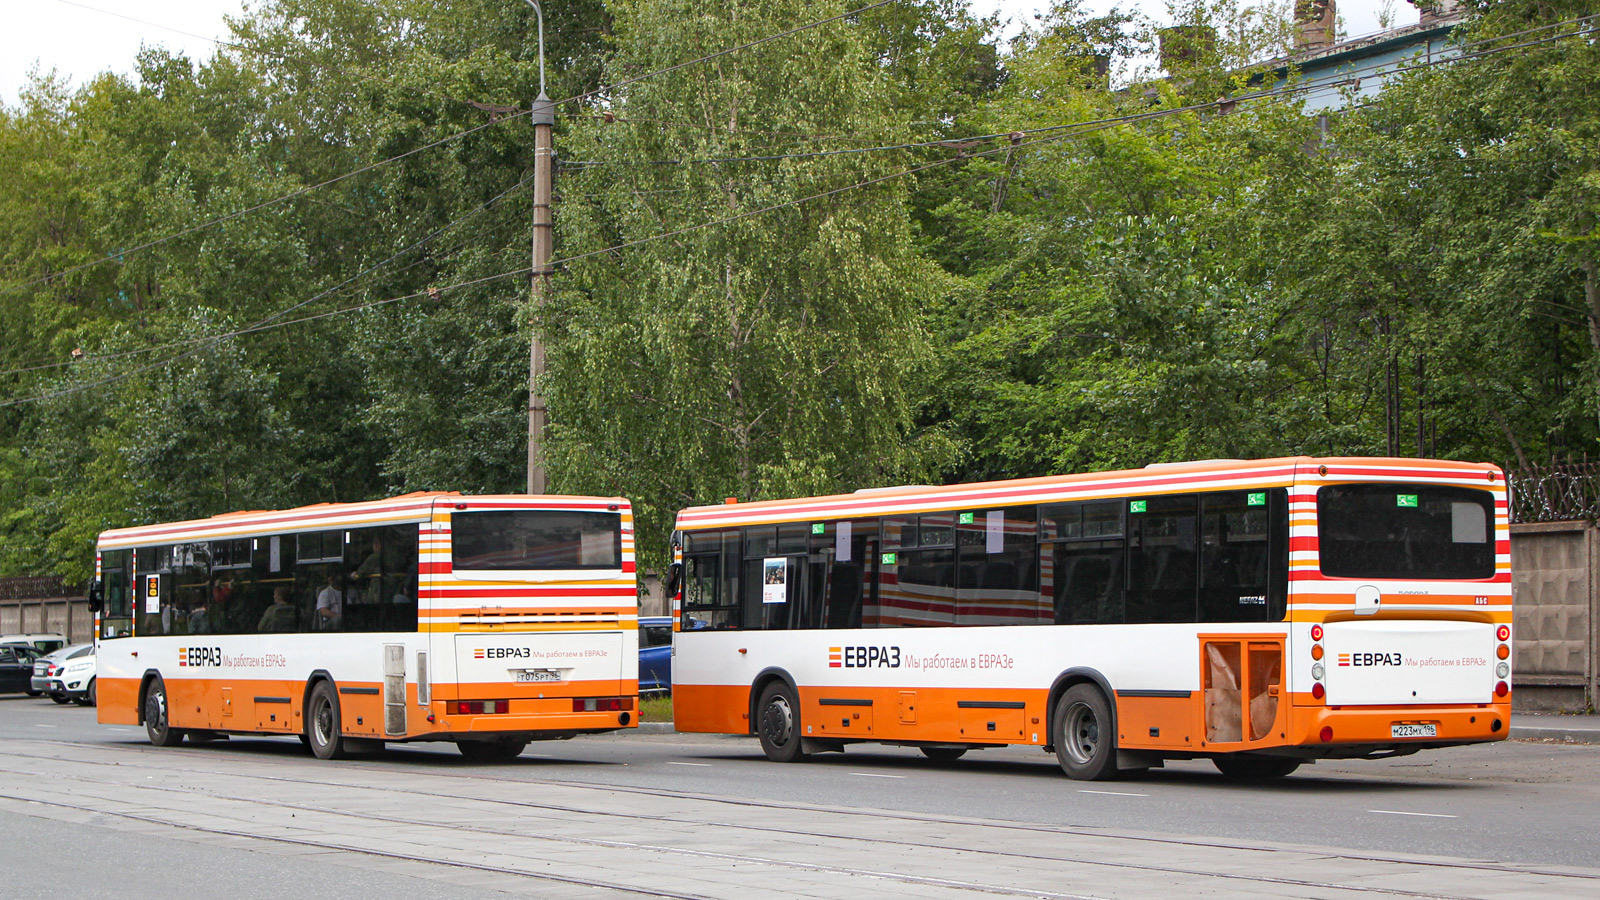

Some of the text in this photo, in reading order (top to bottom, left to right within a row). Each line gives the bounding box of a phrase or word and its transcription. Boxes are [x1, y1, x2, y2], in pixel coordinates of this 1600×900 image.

[188, 647, 221, 667] ЕВРАЗ
[487, 647, 531, 659] ЕВРАЗ
[546, 650, 578, 659] работаем
[584, 650, 608, 658] ЕВРАЗе
[844, 646, 901, 668] ЕВРАЗ
[1353, 653, 1402, 666] ЕВРАЗ
[223, 655, 233, 667] Мы
[234, 653, 260, 670] работаем
[265, 654, 286, 667] ЕВРАЗе
[904, 653, 1014, 672] Мы работаем в ЕВРАЗе
[1405, 658, 1418, 666] Мы
[1419, 657, 1455, 668] работаем
[1462, 658, 1487, 666] ЕВРАЗе
